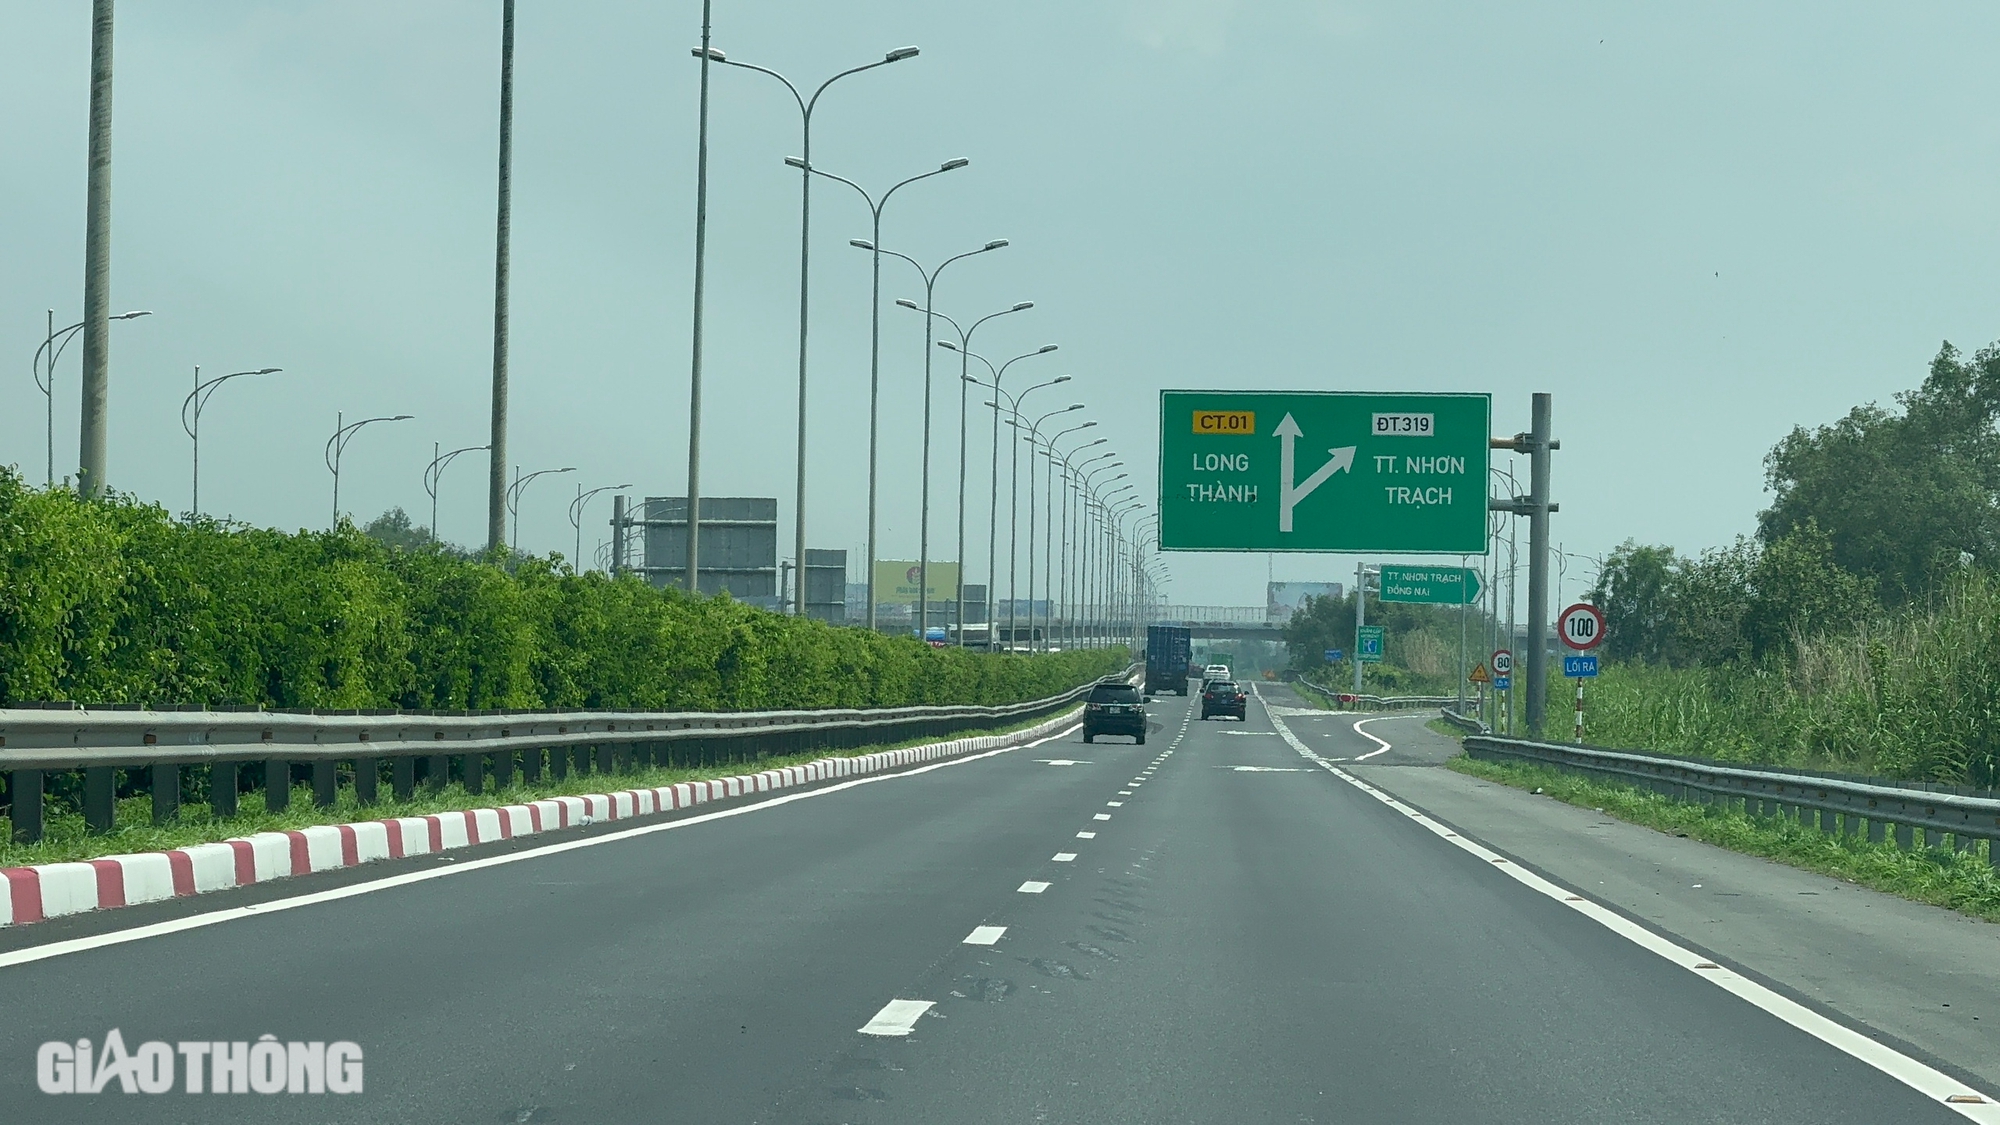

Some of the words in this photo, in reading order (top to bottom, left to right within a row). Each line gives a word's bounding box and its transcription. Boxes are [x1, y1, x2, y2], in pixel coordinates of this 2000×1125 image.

[1200, 414, 1248, 430] CT.01
[1376, 416, 1430, 432] ĐT.319
[1193, 453, 1249, 472] LONG
[1373, 455, 1399, 474] TT.
[1406, 454, 1465, 475] NHƠN
[1186, 480, 1258, 503] THÀNH
[1384, 486, 1452, 510] TRẠCH
[1430, 573, 1462, 584] TRẠCH
[1569, 617, 1594, 637] 100
[1497, 657, 1510, 668] 80
[1566, 658, 1580, 673] LỐI
[1582, 661, 1595, 672] RA
